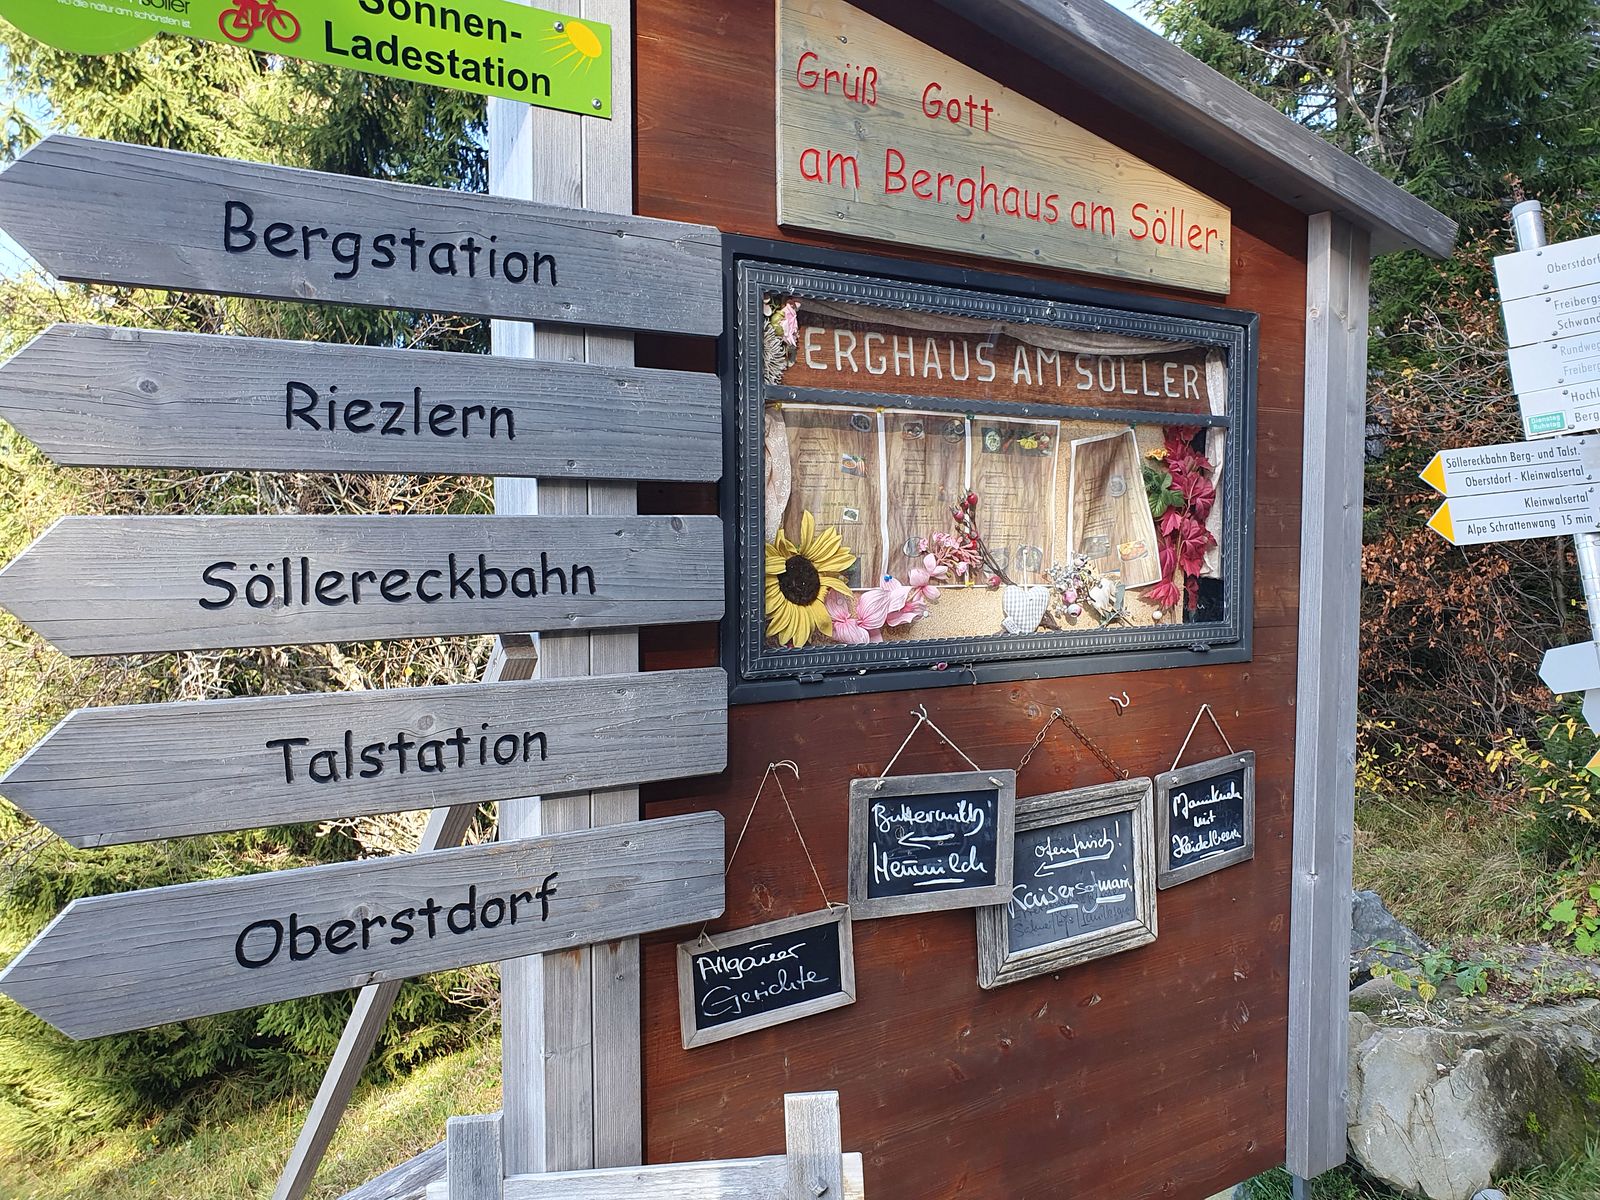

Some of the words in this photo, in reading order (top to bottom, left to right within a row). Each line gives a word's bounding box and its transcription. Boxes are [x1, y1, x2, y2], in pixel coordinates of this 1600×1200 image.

[324, 20, 552, 97] Ladestation
[796, 51, 878, 107] Grüß
[922, 82, 994, 132] Gott
[799, 147, 861, 189] am
[884, 148, 1060, 224] Berghaus
[1071, 201, 1116, 236] am
[1128, 203, 1219, 255] Söller
[223, 200, 559, 287] Bergstation
[1012, 345, 1063, 388] AM
[285, 380, 517, 442] Riezlern
[1574, 410, 1600, 423] Berg
[1446, 453, 1508, 469] Söllereckbahn
[1509, 451, 1535, 463] Berg-
[1537, 446, 1554, 460] und
[1556, 445, 1581, 458] Talst.
[1465, 472, 1512, 487] Oberstdorf
[1520, 465, 1585, 482] Kleinwalsertal
[1467, 524, 1487, 537] Alpe
[1490, 519, 1556, 533] Schrattenwang
[1561, 514, 1573, 526] 15
[1575, 513, 1593, 525] min
[1524, 491, 1589, 508] Kleinwalsertal
[199, 550, 597, 612] Söllereckbahn
[266, 723, 549, 784] Talstation
[1193, 810, 1217, 828] mit
[234, 871, 559, 969] Oberstdorf
[701, 966, 830, 1017] Gerichte
